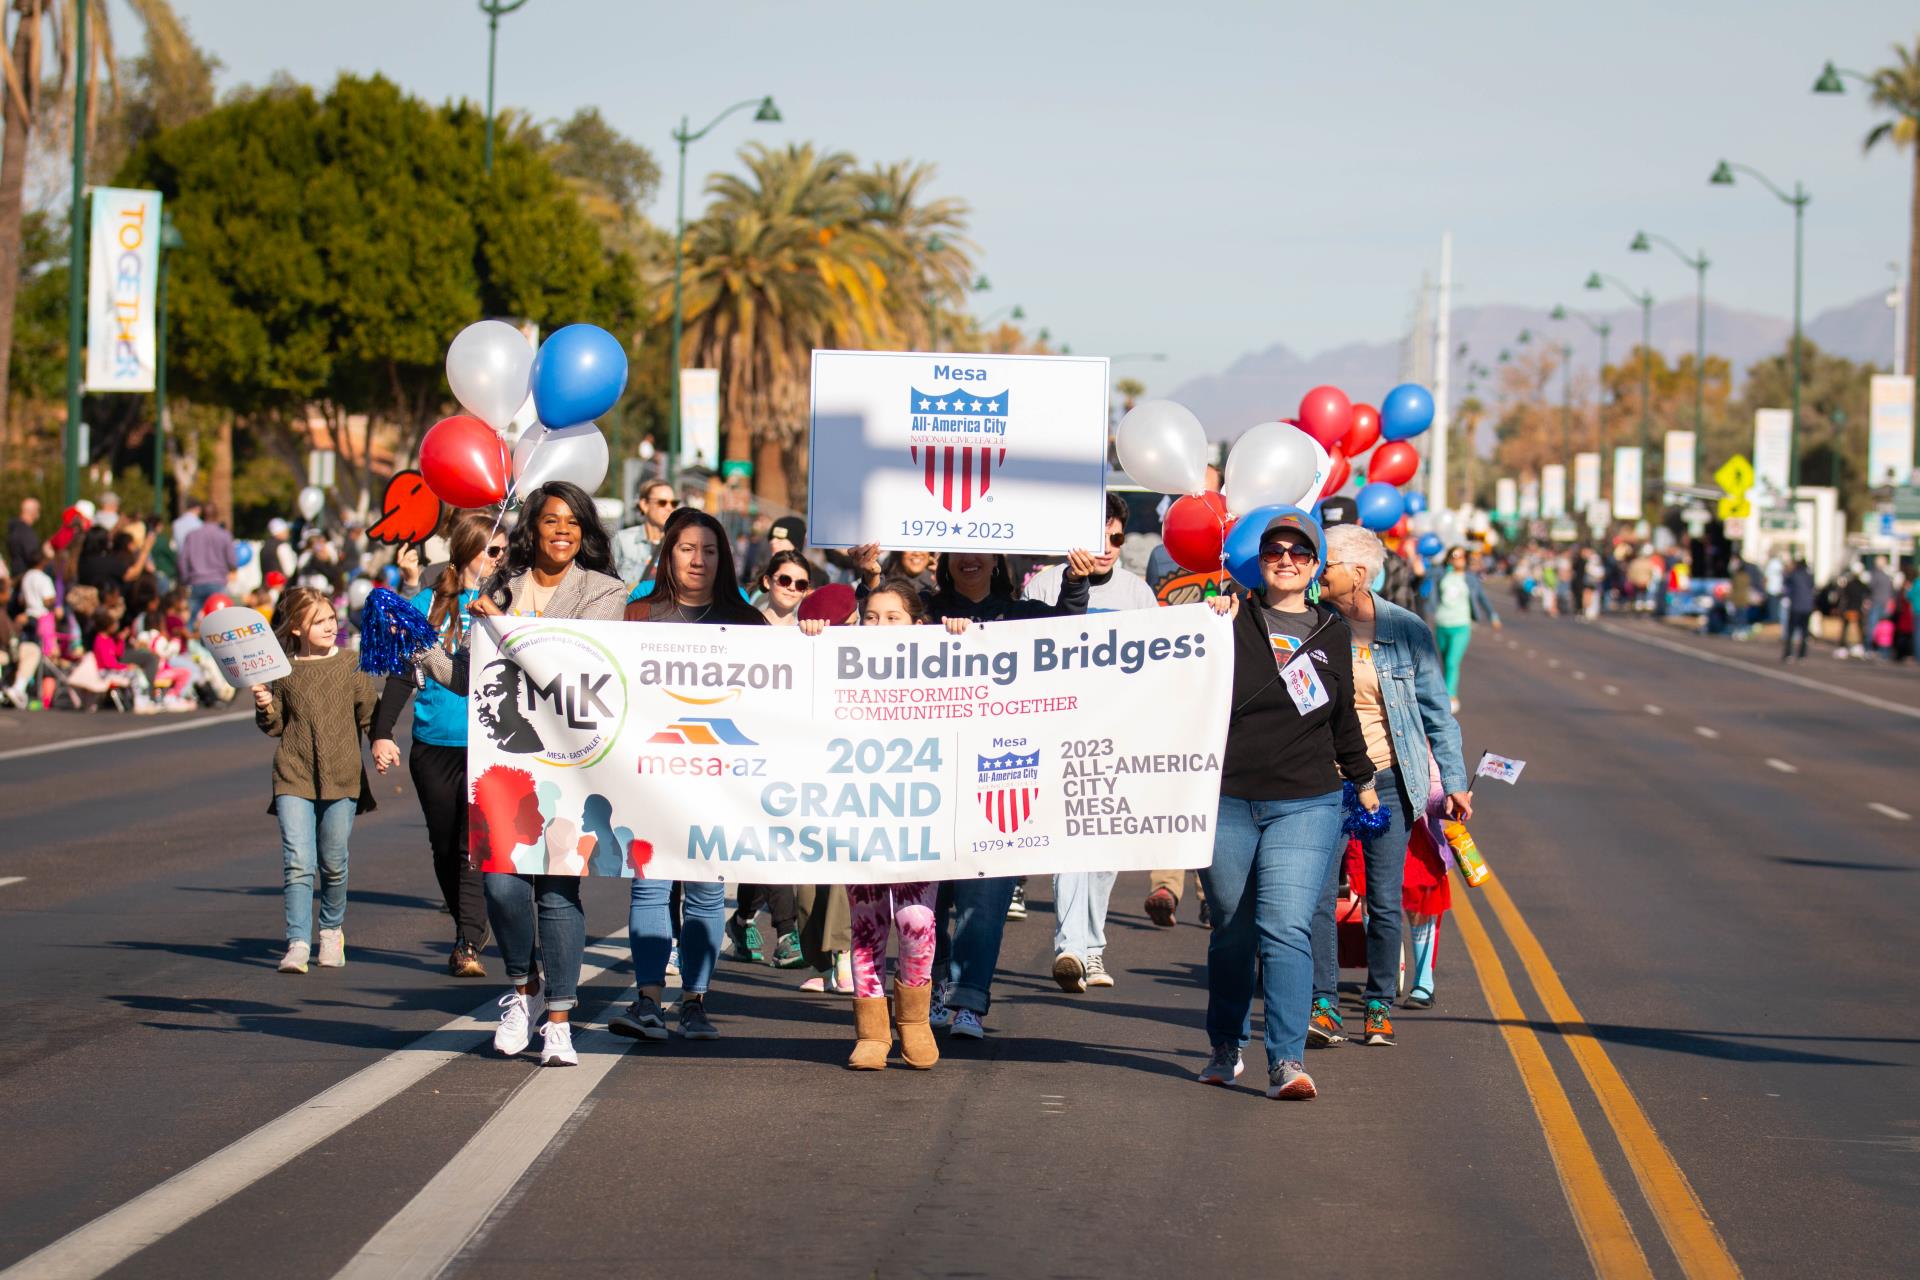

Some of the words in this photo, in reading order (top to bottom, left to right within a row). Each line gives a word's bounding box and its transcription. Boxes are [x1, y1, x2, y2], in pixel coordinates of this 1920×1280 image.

[934, 365, 987, 381] Mesa
[912, 416, 980, 433] All-America
[984, 418, 1007, 436] City
[901, 520, 947, 536] 1979
[967, 522, 1014, 539] 2023
[206, 622, 266, 645] TOGETHER
[511, 641, 531, 654] Martin
[640, 643, 707, 653] PRESENTED
[711, 644, 728, 654] BY:
[837, 641, 1018, 685] Building
[1033, 629, 1206, 674] Bridges:
[640, 659, 793, 690] amazon
[523, 671, 615, 731] MLK
[834, 685, 989, 704] TRANSFORMING
[834, 701, 973, 721] COMMUNITIES
[978, 696, 1078, 717] TOGETHER
[992, 737, 1027, 748] Mesa
[1061, 738, 1114, 759] 2023
[546, 751, 567, 760] MESA
[826, 737, 943, 774] 2024
[1062, 753, 1219, 779] ALL-AMERICA
[978, 769, 1022, 783] All-America
[1023, 768, 1038, 780] City
[1063, 777, 1118, 797] CITY
[760, 781, 942, 818] GRAND
[1064, 796, 1132, 817] MESA
[1066, 814, 1207, 837] DELEGATION
[687, 825, 941, 863] MARSHALL
[972, 839, 1004, 853] 1979
[1017, 836, 1050, 849] 2023
